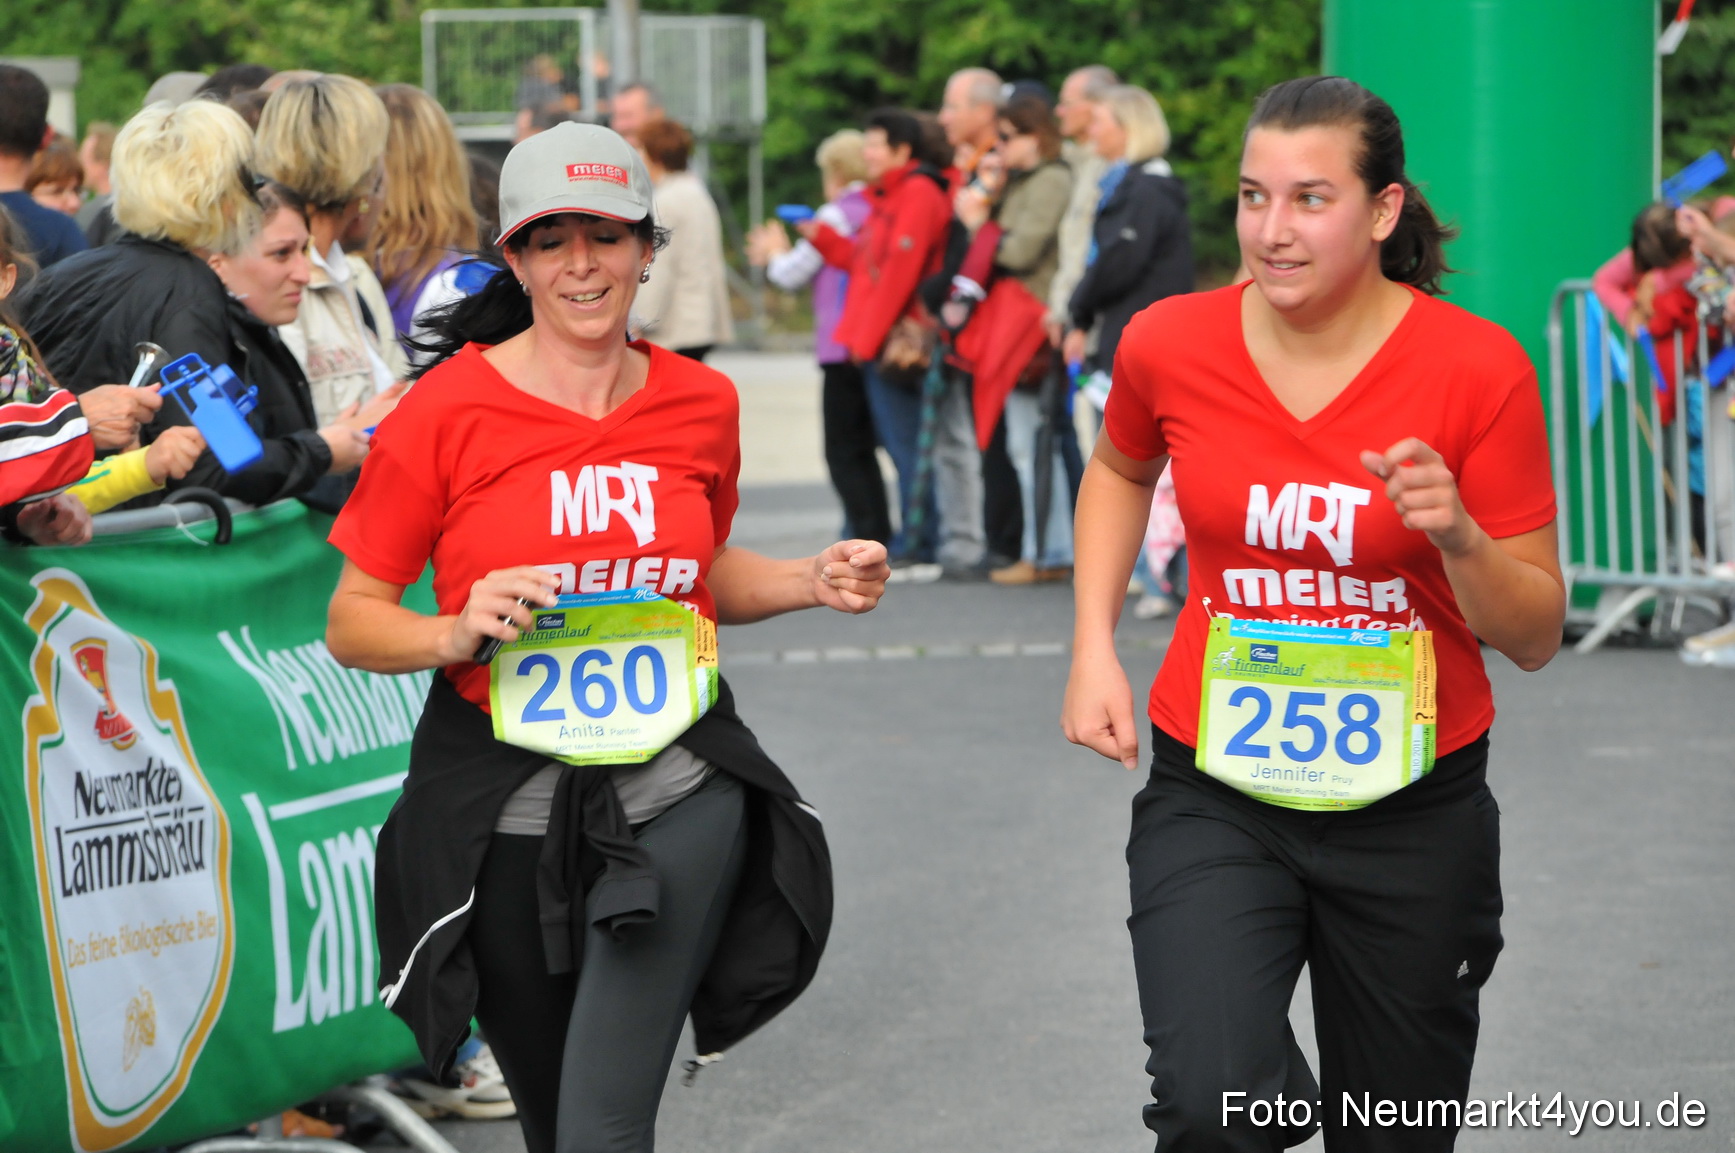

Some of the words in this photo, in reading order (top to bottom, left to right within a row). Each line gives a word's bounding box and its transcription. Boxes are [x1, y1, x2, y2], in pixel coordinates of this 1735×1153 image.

[573, 164, 623, 178] MEIER
[550, 461, 659, 548] MRT
[1245, 481, 1371, 567] MRT
[1222, 568, 1408, 613] MEIER
[516, 644, 668, 724] 260
[1235, 658, 1306, 677] firmenlauf
[559, 723, 604, 739] Anita
[1223, 685, 1382, 765] 258
[1415, 711, 1434, 721] ?
[74, 756, 183, 819] Neumarkter
[1250, 763, 1325, 782] Jennifer
[1253, 784, 1270, 792] MRT
[1272, 786, 1292, 794] Meier
[1295, 787, 1327, 798] Running
[1329, 789, 1350, 797] Team
[54, 808, 206, 898] Lammsbräu
[241, 792, 385, 1033] Lam
[68, 937, 86, 968] Das
[89, 932, 117, 962] feine
[119, 915, 195, 958] ökologische
